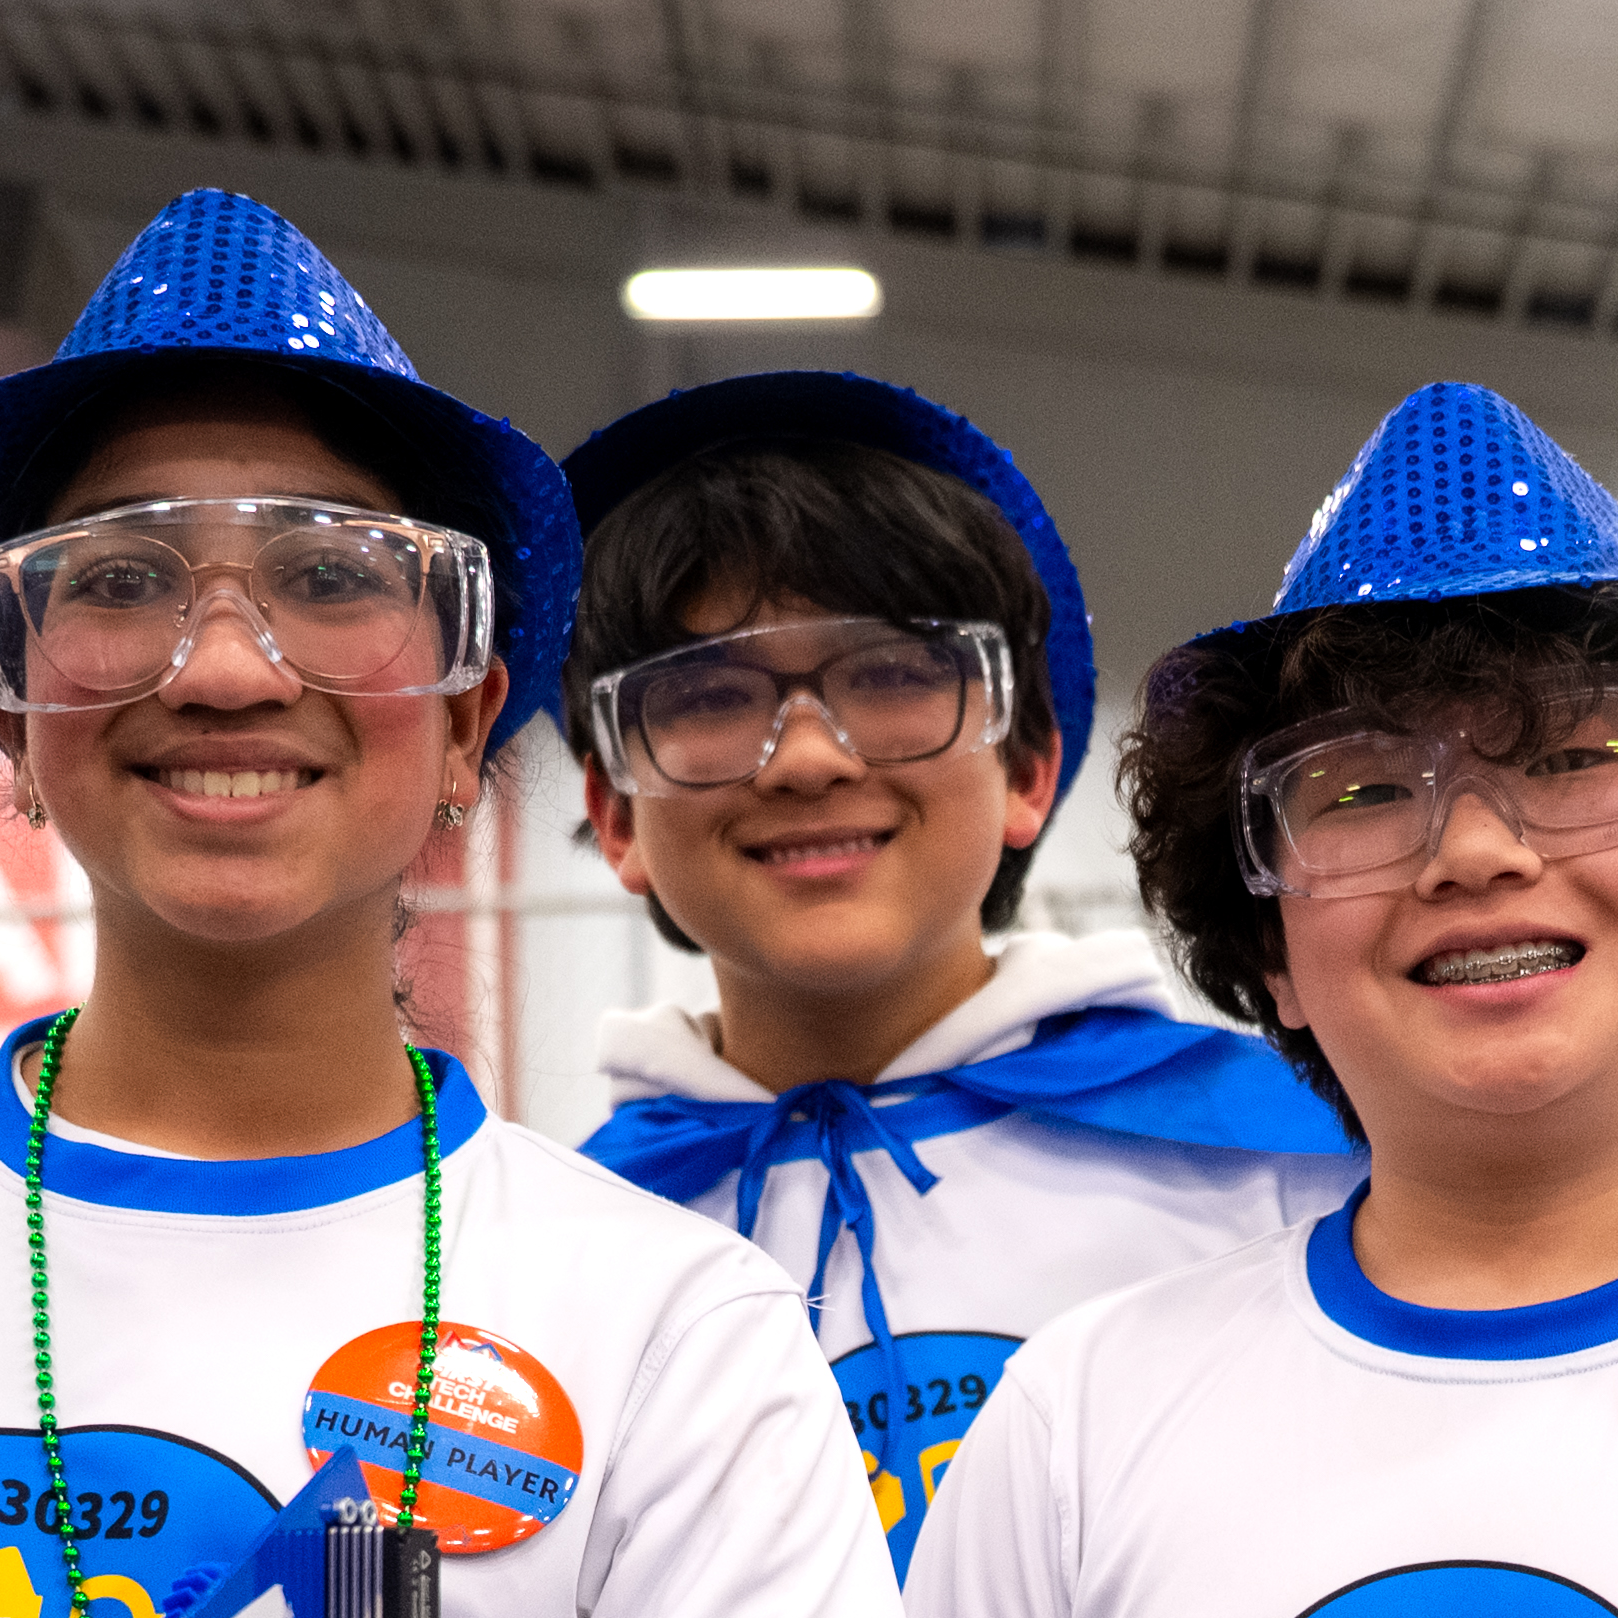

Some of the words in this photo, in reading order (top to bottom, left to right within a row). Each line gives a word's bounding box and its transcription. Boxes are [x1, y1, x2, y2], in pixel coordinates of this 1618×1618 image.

[429, 1377, 486, 1406] TECH
[845, 1374, 987, 1435] 30329
[447, 1448, 560, 1505] PLAYER
